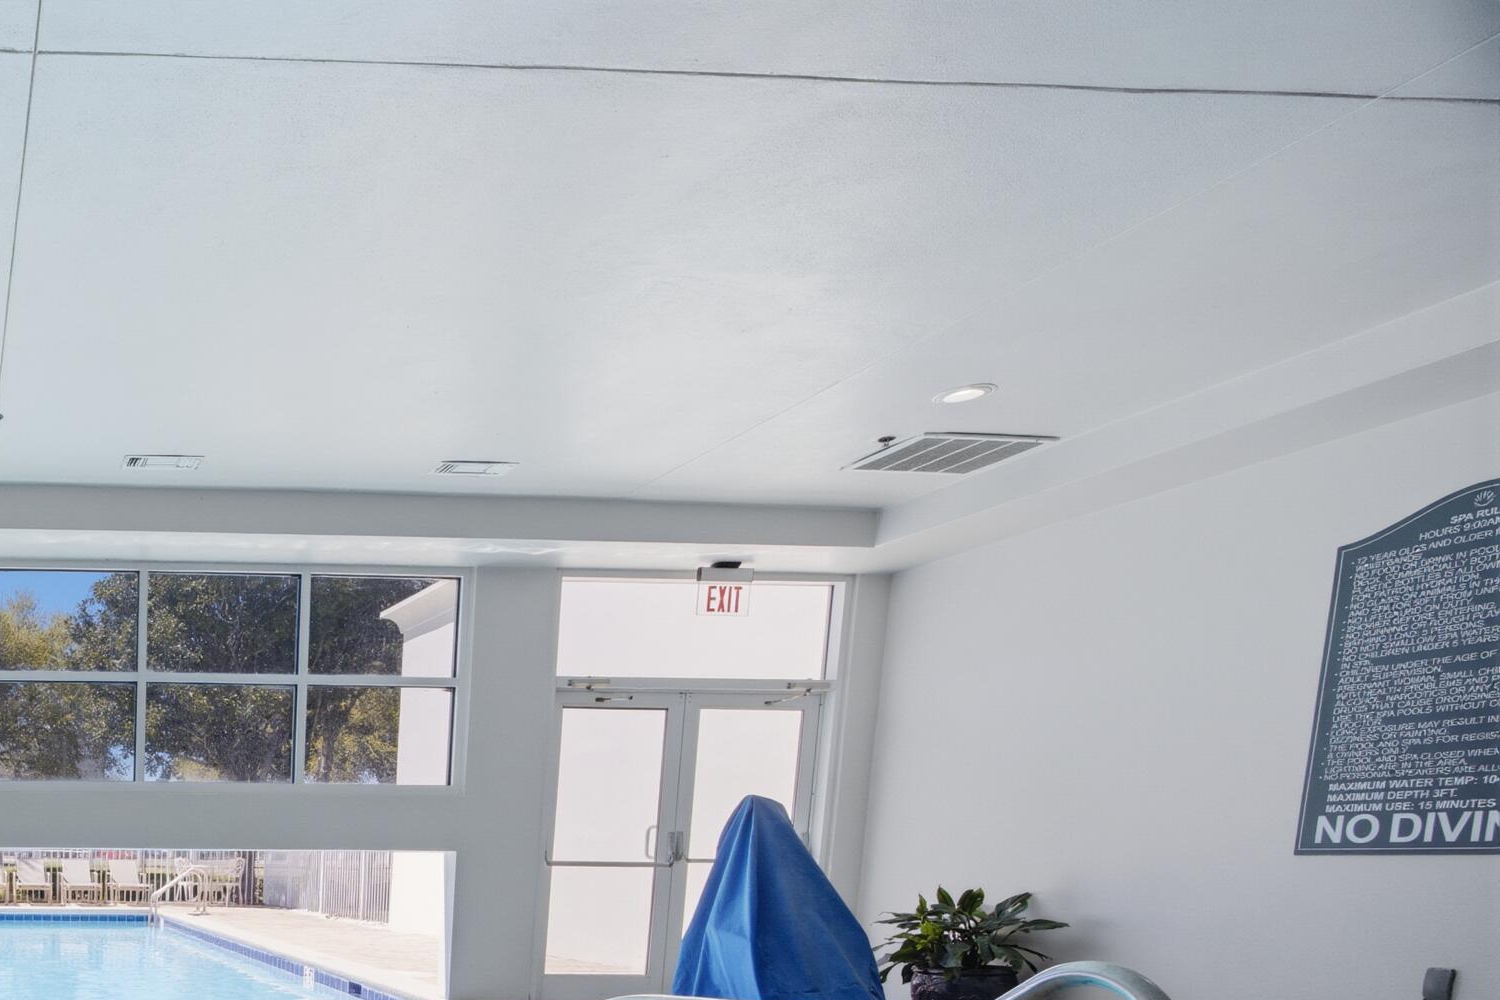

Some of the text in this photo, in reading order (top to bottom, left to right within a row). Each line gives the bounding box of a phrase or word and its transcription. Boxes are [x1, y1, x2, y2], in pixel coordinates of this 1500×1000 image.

[1450, 512, 1474, 524] SPA
[1419, 524, 1461, 540] HOURS
[1369, 550, 1396, 561] YEAR
[1428, 538, 1451, 549] AND
[1453, 530, 1493, 544] OLDER
[1371, 564, 1400, 576] FOOD
[1420, 554, 1453, 566] DRINK
[1455, 551, 1467, 559] IN
[1394, 572, 1441, 586] BOTTLES
[1419, 582, 1467, 597] ANIMALS
[1469, 580, 1479, 588] IN
[1440, 589, 1472, 601] FROM
[706, 586, 743, 613] EXIT
[1424, 603, 1439, 612] ON
[1429, 614, 1470, 627] ROUGH
[1359, 643, 1379, 652] NOT
[1437, 631, 1459, 640] SPA
[1341, 654, 1356, 662] NO
[1358, 646, 1409, 659] CHILDREN
[1411, 640, 1450, 652] UNDER
[1390, 659, 1428, 670] UNDER
[1431, 655, 1453, 664] THE
[1453, 652, 1477, 662] AGE
[1479, 649, 1497, 658] OF
[1439, 669, 1473, 680] SMALL
[1403, 679, 1462, 692] PROBLEMS
[1463, 676, 1488, 685] AND
[1386, 688, 1447, 701] NARCOTICS
[1449, 686, 1466, 694] OR
[1467, 683, 1491, 692] ANY
[1397, 698, 1433, 707] CAUSE
[1397, 706, 1432, 715] POOLS
[1435, 700, 1486, 711] WITHOUT
[1417, 720, 1440, 728] MAY
[1442, 716, 1485, 726] RESULT
[1376, 739, 1399, 748] AND
[1401, 737, 1421, 746] SPA
[1422, 736, 1434, 744] IS
[1435, 734, 1459, 743] FOR
[1326, 758, 1345, 766] THE
[1397, 753, 1419, 761] SPA
[1420, 750, 1464, 759] CLOSED
[1400, 761, 1412, 769] IN
[1414, 760, 1434, 768] THE
[1394, 766, 1451, 776] SPEAKERS
[1452, 765, 1476, 773] ARE
[1328, 780, 1386, 790] MAXIMUM
[1388, 778, 1433, 787] WATER
[1437, 775, 1477, 785] TEMP:
[1326, 788, 1458, 802] MAXIMUM DEPTH 3FT.
[1325, 798, 1496, 812] MAXIMUM USE: 15 MINUTES
[1314, 813, 1381, 843] NO
